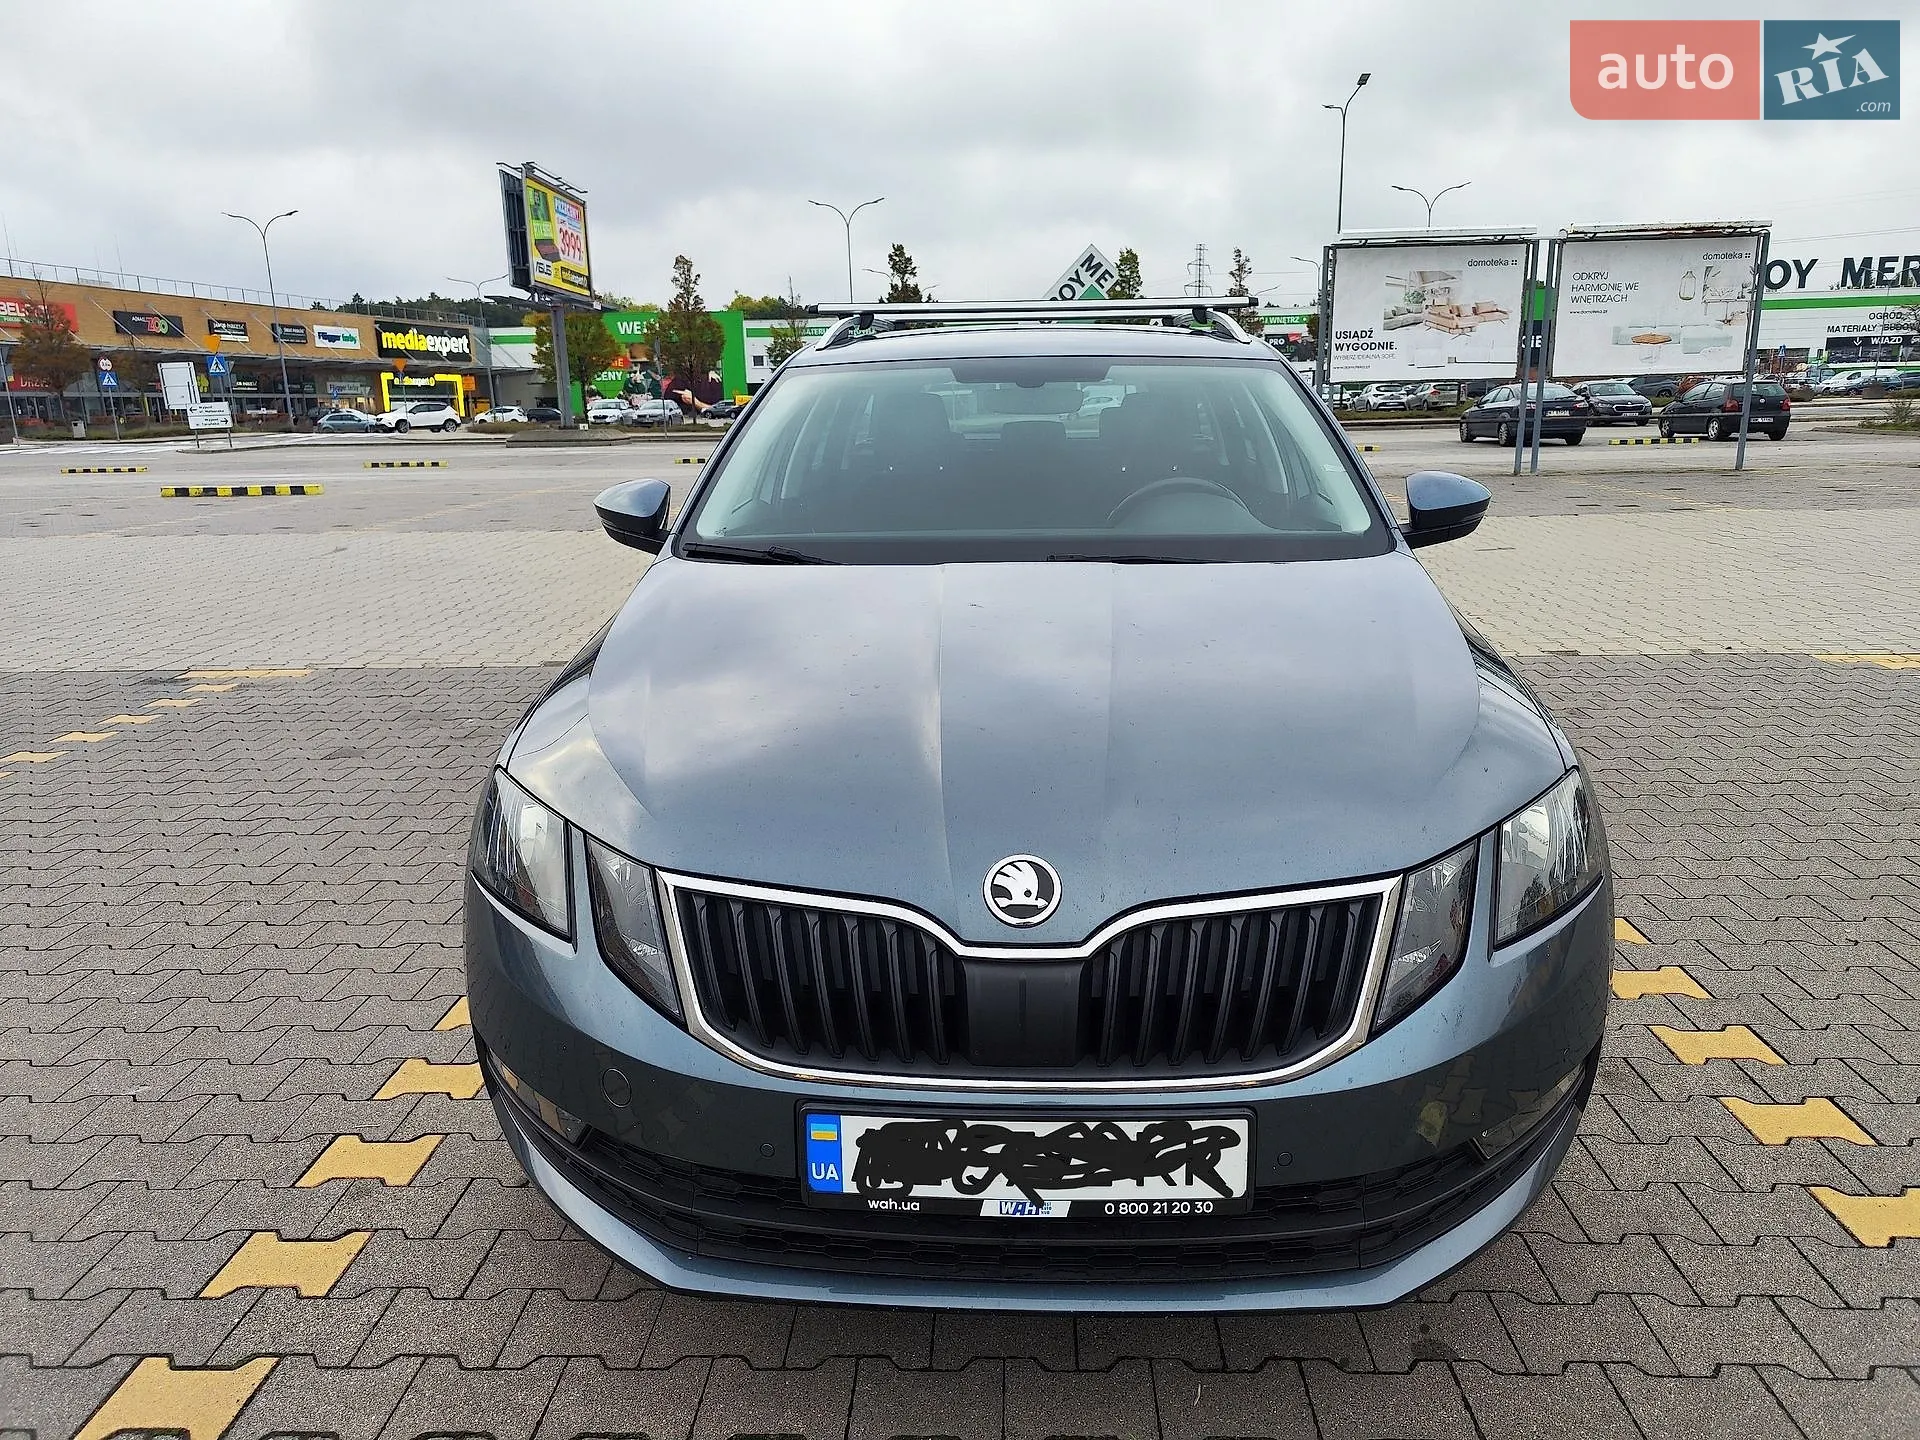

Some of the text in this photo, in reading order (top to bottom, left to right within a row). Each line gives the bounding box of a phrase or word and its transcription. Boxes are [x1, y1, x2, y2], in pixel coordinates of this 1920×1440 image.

[1702, 252, 1743, 260] domoteka
[1467, 258, 1509, 267] domoteka
[1572, 271, 1609, 281] ODKRYJ
[1764, 255, 1920, 290] OY MER
[1624, 282, 1639, 291] WE
[1335, 327, 1374, 341] USIĄDŹ
[381, 327, 470, 357] mediaexpert
[1268, 338, 1285, 346] PRO
[1871, 336, 1903, 345] WJAZD
[1334, 341, 1398, 352] WYGODNIE.
[811, 1162, 839, 1181] UA
[867, 1198, 920, 1211] wah.ua
[1105, 1200, 1214, 1215] 0 800 21 20 30
